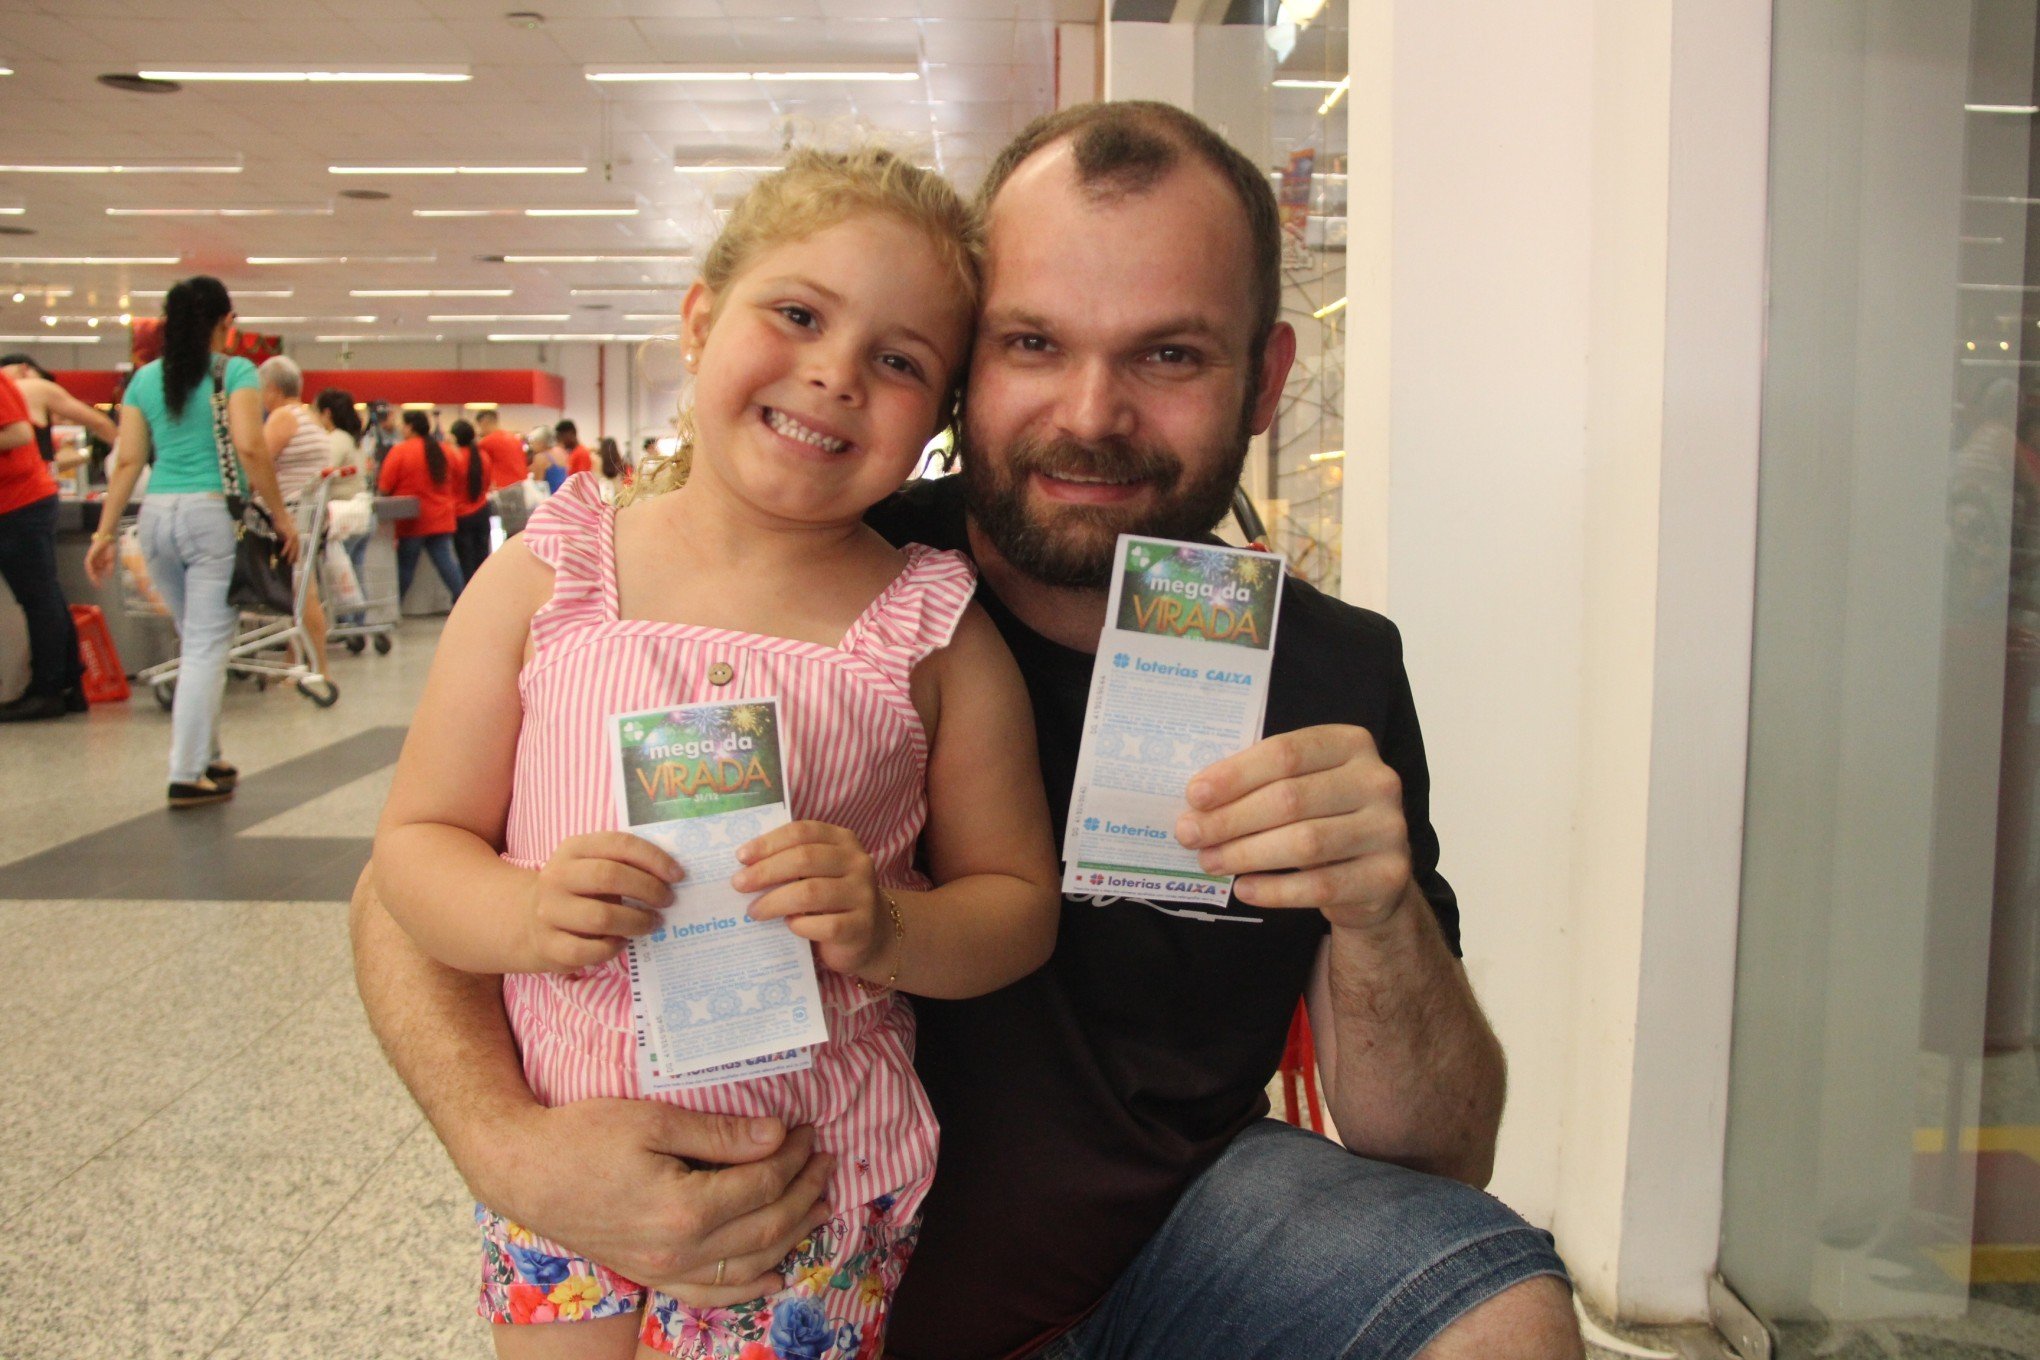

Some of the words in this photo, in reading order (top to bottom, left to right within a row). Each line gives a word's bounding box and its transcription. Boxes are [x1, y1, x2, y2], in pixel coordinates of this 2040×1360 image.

[1150, 576, 1213, 599] mega
[1220, 579, 1251, 602] da
[1133, 594, 1259, 644] VIRADA
[1135, 657, 1197, 678] loterias
[1205, 669, 1252, 686] CAIXA
[649, 740, 715, 760] mega
[722, 732, 753, 751] da
[636, 755, 773, 801] VIRADA
[1105, 820, 1167, 839] loterias
[1107, 875, 1161, 890] loterias
[1165, 880, 1217, 895] CAIXA
[672, 916, 736, 939] loterias
